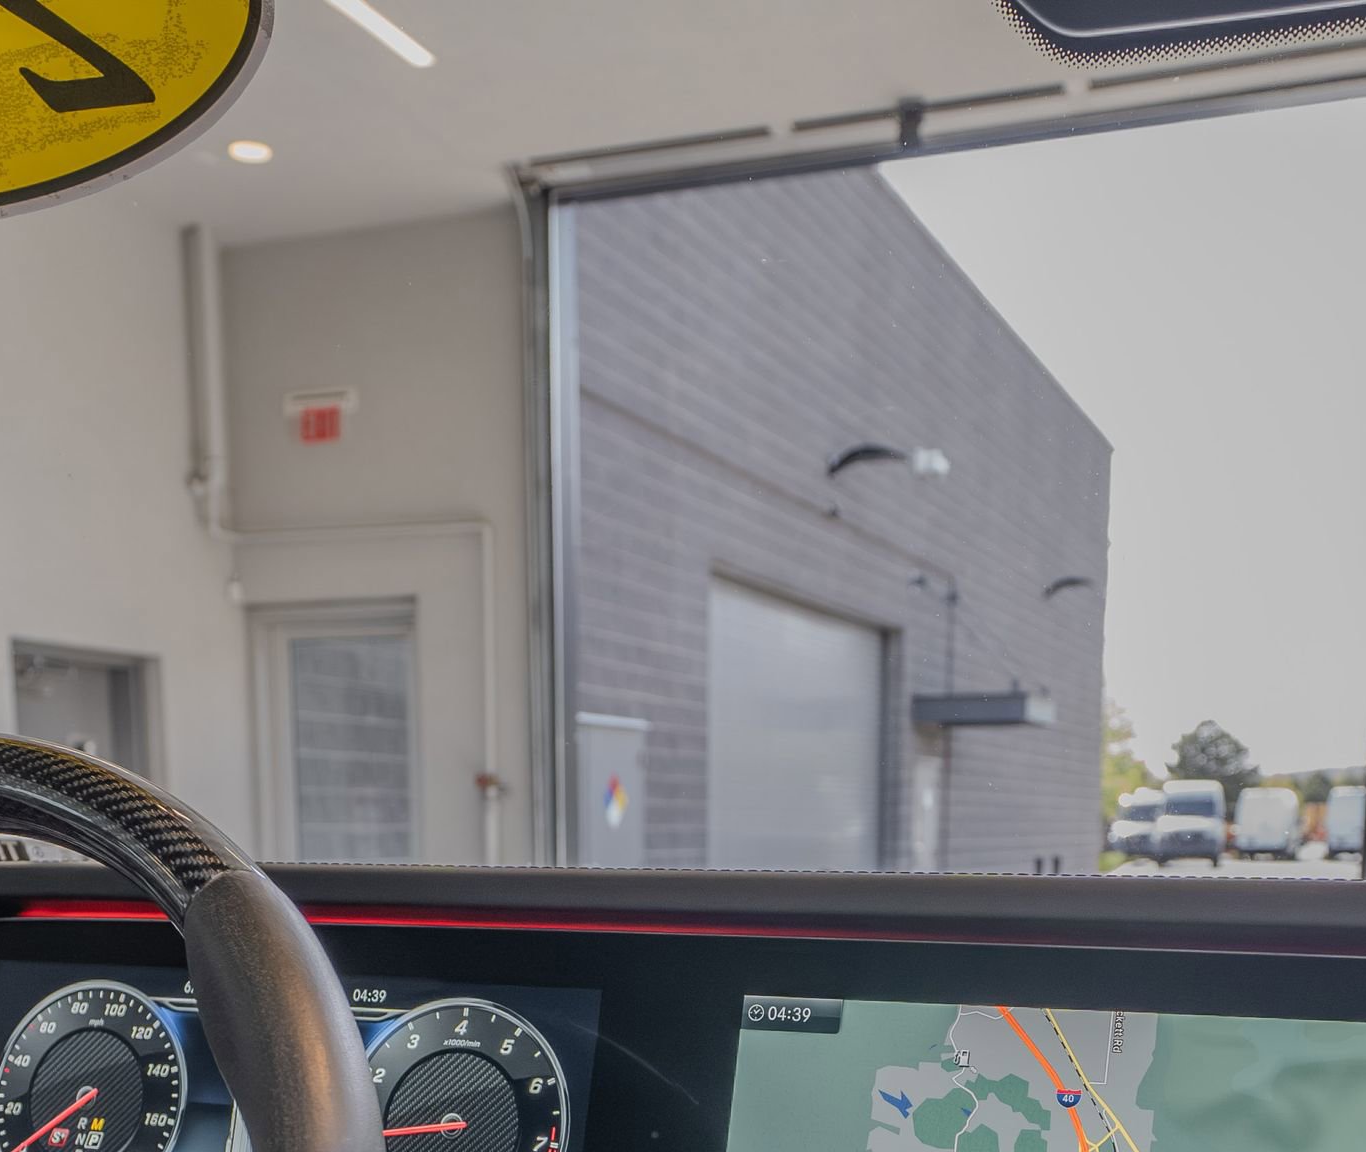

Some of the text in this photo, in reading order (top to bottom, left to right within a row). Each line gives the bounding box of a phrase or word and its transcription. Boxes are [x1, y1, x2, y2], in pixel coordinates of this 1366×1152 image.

[353, 988, 387, 1002] 04:39
[71, 1002, 89, 1014] 80
[104, 1003, 128, 1017] 100
[767, 1005, 812, 1023] 04:39
[39, 1022, 56, 1034] 60
[88, 1018, 105, 1028] mph
[454, 1019, 469, 1035] 4
[130, 1026, 154, 1040] 120
[406, 1033, 421, 1049] 3
[500, 1039, 515, 1055] 5
[1112, 1039, 1124, 1053] Rd
[13, 1055, 31, 1067] 40
[147, 1063, 171, 1077] 140
[371, 1067, 386, 1083] 2
[528, 1077, 544, 1095] 6
[1062, 1094, 1075, 1104] 40
[4, 1102, 22, 1115] 20
[77, 1117, 88, 1130] R
[90, 1118, 105, 1131] M
[144, 1112, 168, 1127] 160
[75, 1132, 87, 1146] N
[88, 1134, 100, 1147] P
[532, 1136, 548, 1152] 7
